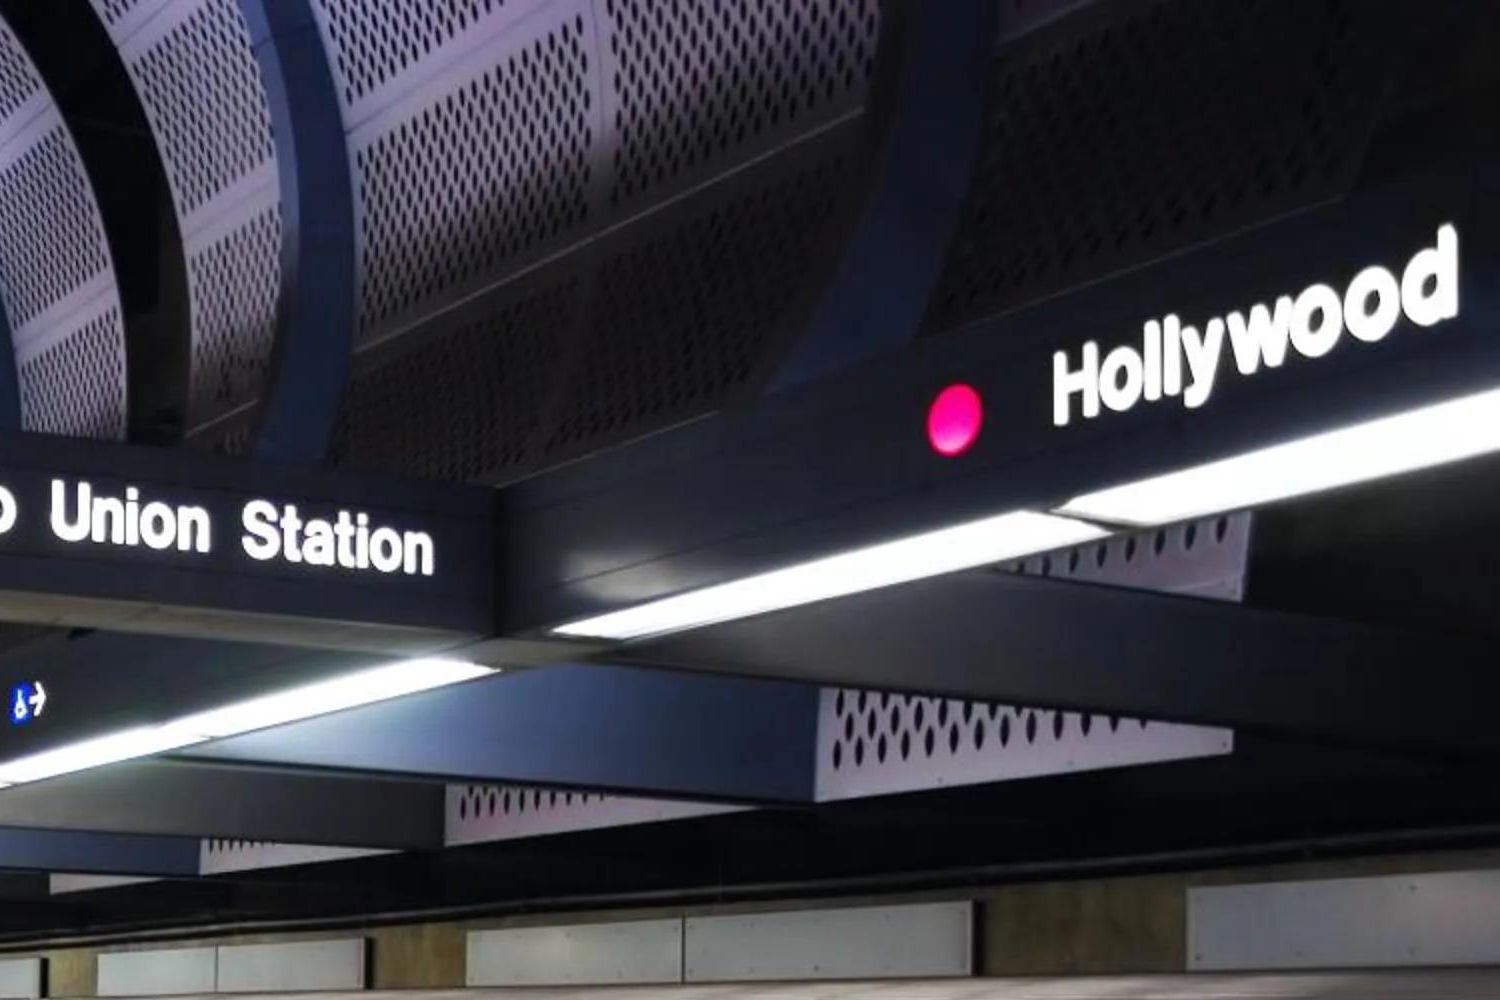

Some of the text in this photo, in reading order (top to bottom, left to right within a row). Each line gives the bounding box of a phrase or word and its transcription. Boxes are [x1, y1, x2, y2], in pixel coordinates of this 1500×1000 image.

[1052, 222, 1460, 427] Hollywood
[49, 478, 211, 554] Union
[241, 499, 435, 576] Station
